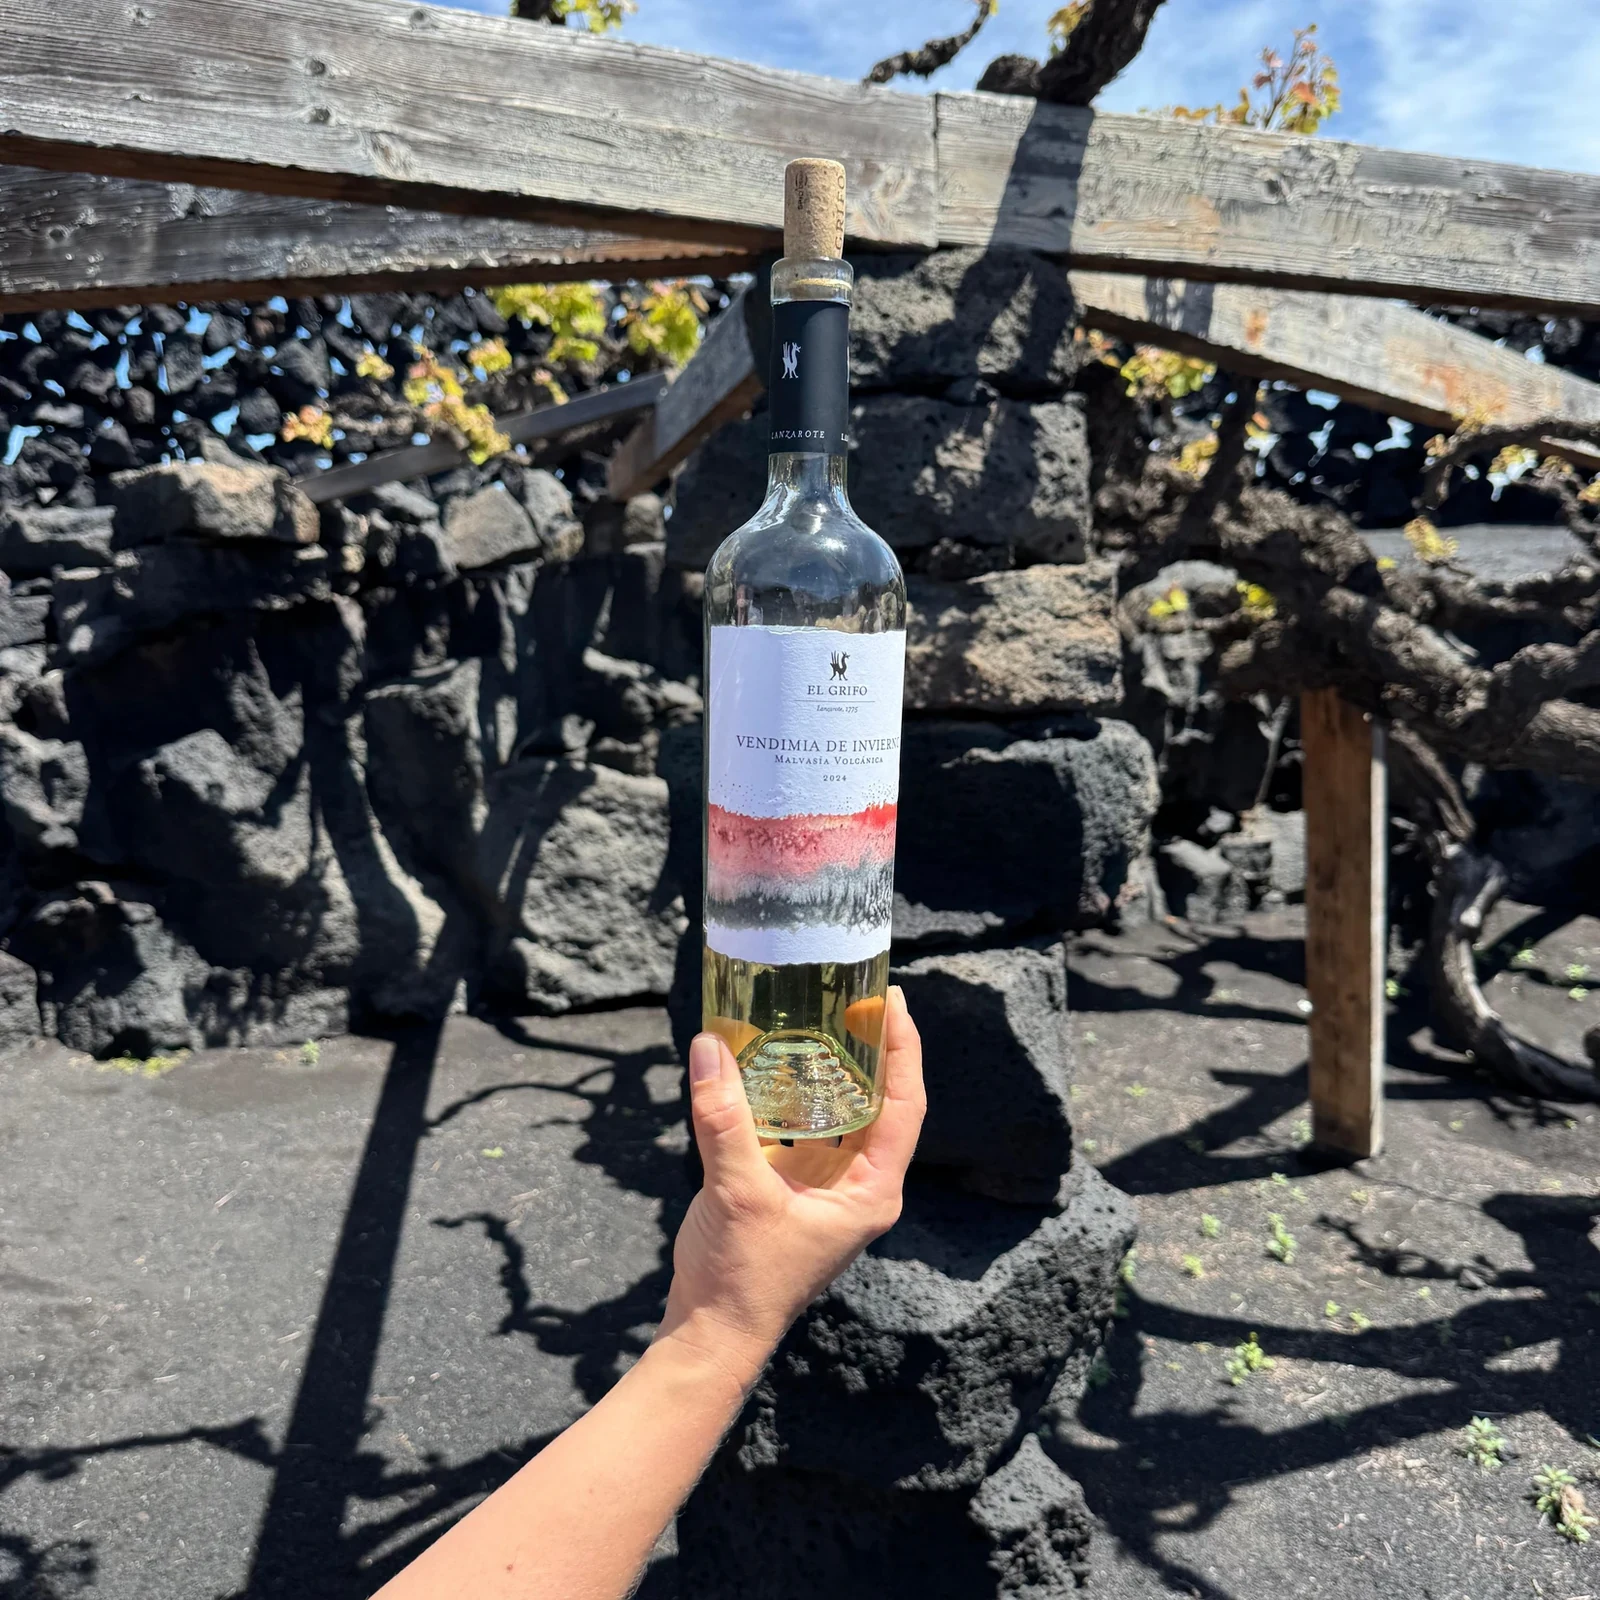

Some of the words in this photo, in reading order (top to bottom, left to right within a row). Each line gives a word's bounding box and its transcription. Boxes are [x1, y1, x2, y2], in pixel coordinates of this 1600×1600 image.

[771, 430, 825, 439] LANZAROTE
[807, 685, 824, 696] EL
[828, 685, 868, 696] GRIFO
[845, 705, 858, 713] 1775
[736, 735, 820, 752] VENDIMIA
[827, 740, 848, 752] DE
[774, 754, 830, 765] MALVASÍA
[834, 755, 884, 765] VOLCÁNICA
[823, 774, 847, 782] 2024
